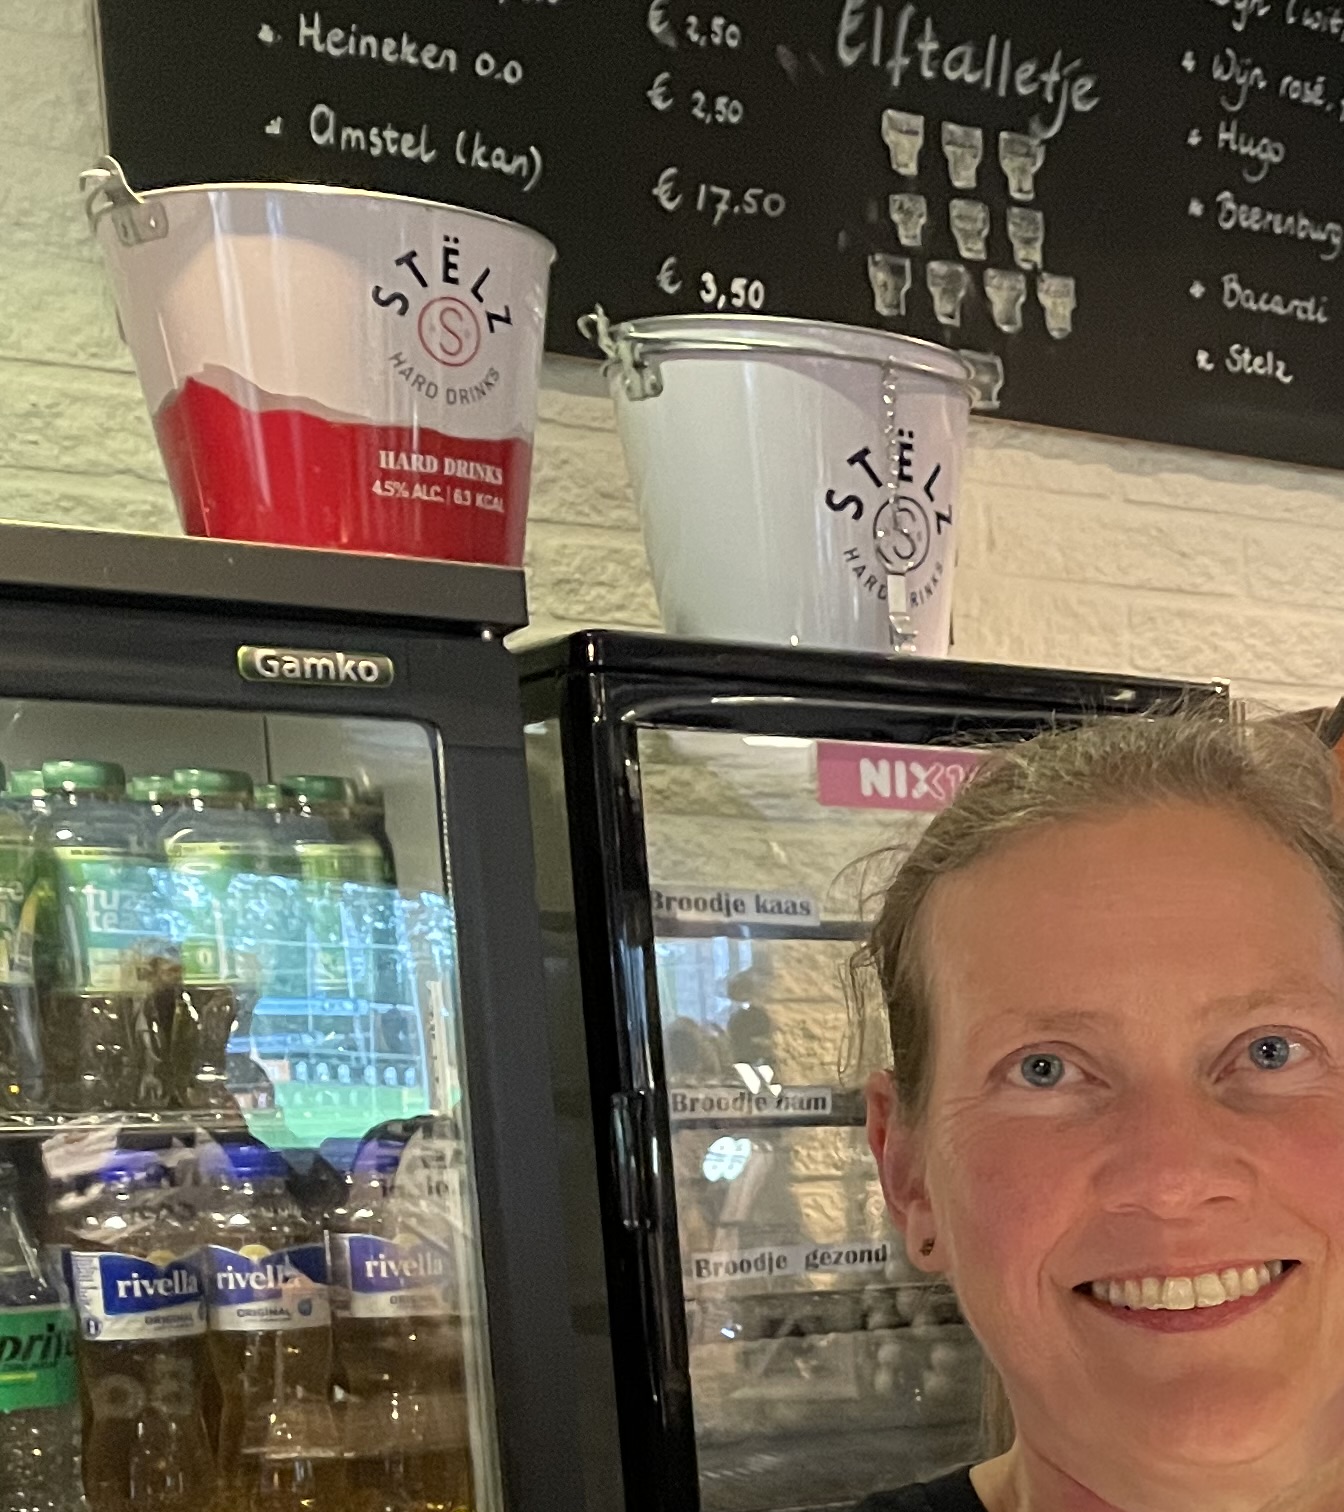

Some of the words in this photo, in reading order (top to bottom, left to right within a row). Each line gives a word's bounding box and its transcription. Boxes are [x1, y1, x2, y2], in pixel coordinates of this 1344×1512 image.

[299, 12, 457, 72] Heineken
[475, 52, 522, 84] 0.0
[686, 15, 741, 48] 2,50
[837, 0, 1100, 140] Elftalletje
[1212, 47, 1267, 112] Wijn
[646, 72, 674, 111] €
[691, 90, 743, 124] 2,50
[310, 104, 436, 163] Amstel
[455, 130, 543, 191] (kan)
[1218, 119, 1285, 182] Hugo
[652, 167, 683, 211] €
[372, 235, 513, 333] STËLZ
[657, 256, 682, 294] €
[700, 271, 765, 309] 3,50
[1221, 273, 1328, 323] Bacardi
[389, 352, 438, 400] HARD
[446, 367, 500, 405] DRINKS
[1225, 344, 1294, 384] Stelz
[379, 450, 438, 476] HARD
[443, 457, 503, 486] DRINKS
[909, 561, 943, 608] RINKS
[254, 649, 380, 683] Gamko
[650, 890, 745, 918] Broodje
[755, 894, 811, 916] kaas
[116, 1271, 199, 1299] rivella
[216, 1264, 296, 1291] rivell
[365, 1253, 442, 1279] rivella
[695, 1252, 788, 1279] Broodje
[804, 1244, 888, 1271] gezond
